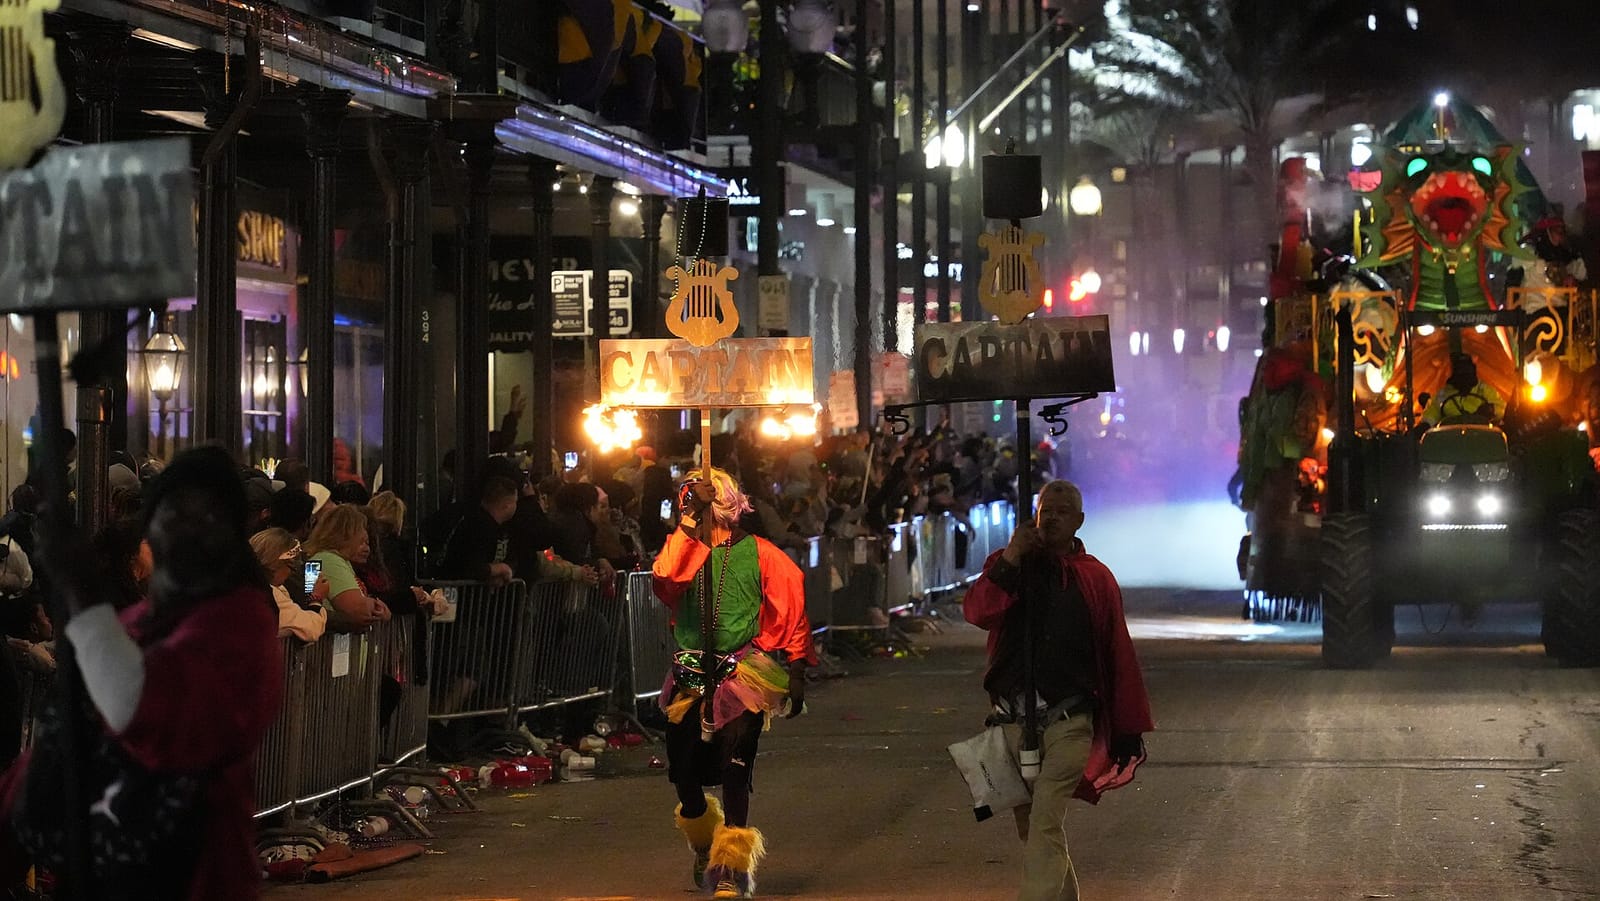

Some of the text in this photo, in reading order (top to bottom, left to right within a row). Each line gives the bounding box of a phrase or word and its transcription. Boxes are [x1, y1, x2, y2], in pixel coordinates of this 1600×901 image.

[0, 172, 190, 281] TAIN
[238, 209, 285, 268] SHOP
[488, 331, 534, 342] UALITY
[920, 331, 1107, 384] CAPTAIN
[603, 349, 813, 394] CAPTAIN
